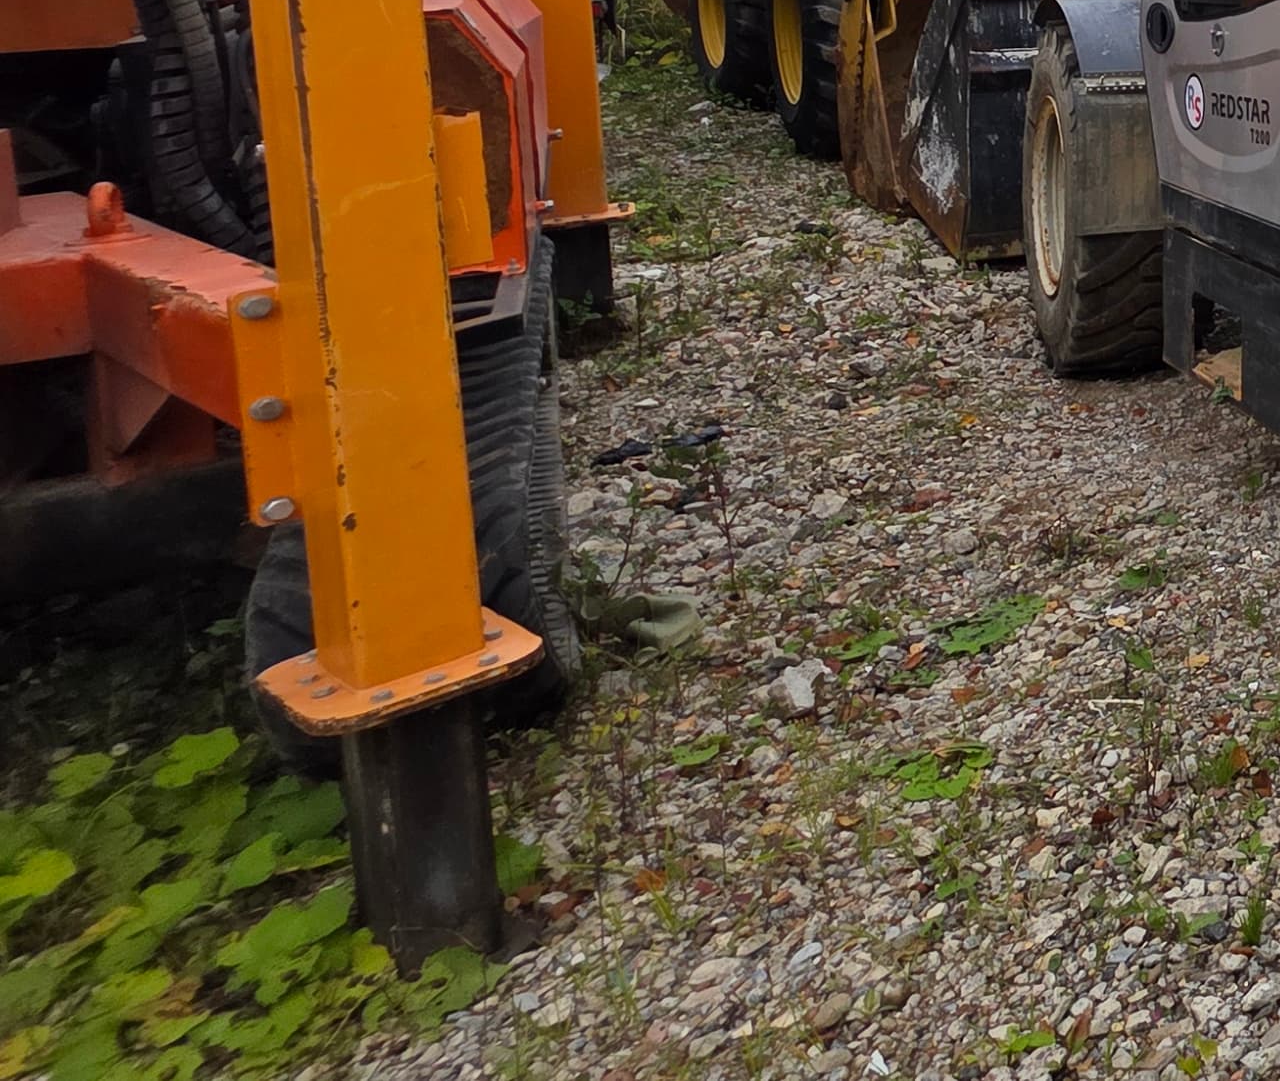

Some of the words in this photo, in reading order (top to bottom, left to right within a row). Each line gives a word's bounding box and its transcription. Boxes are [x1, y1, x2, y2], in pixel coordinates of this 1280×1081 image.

[1187, 85, 1202, 122] RS
[1211, 92, 1270, 124] REDSTAR
[1250, 127, 1271, 146] T200
